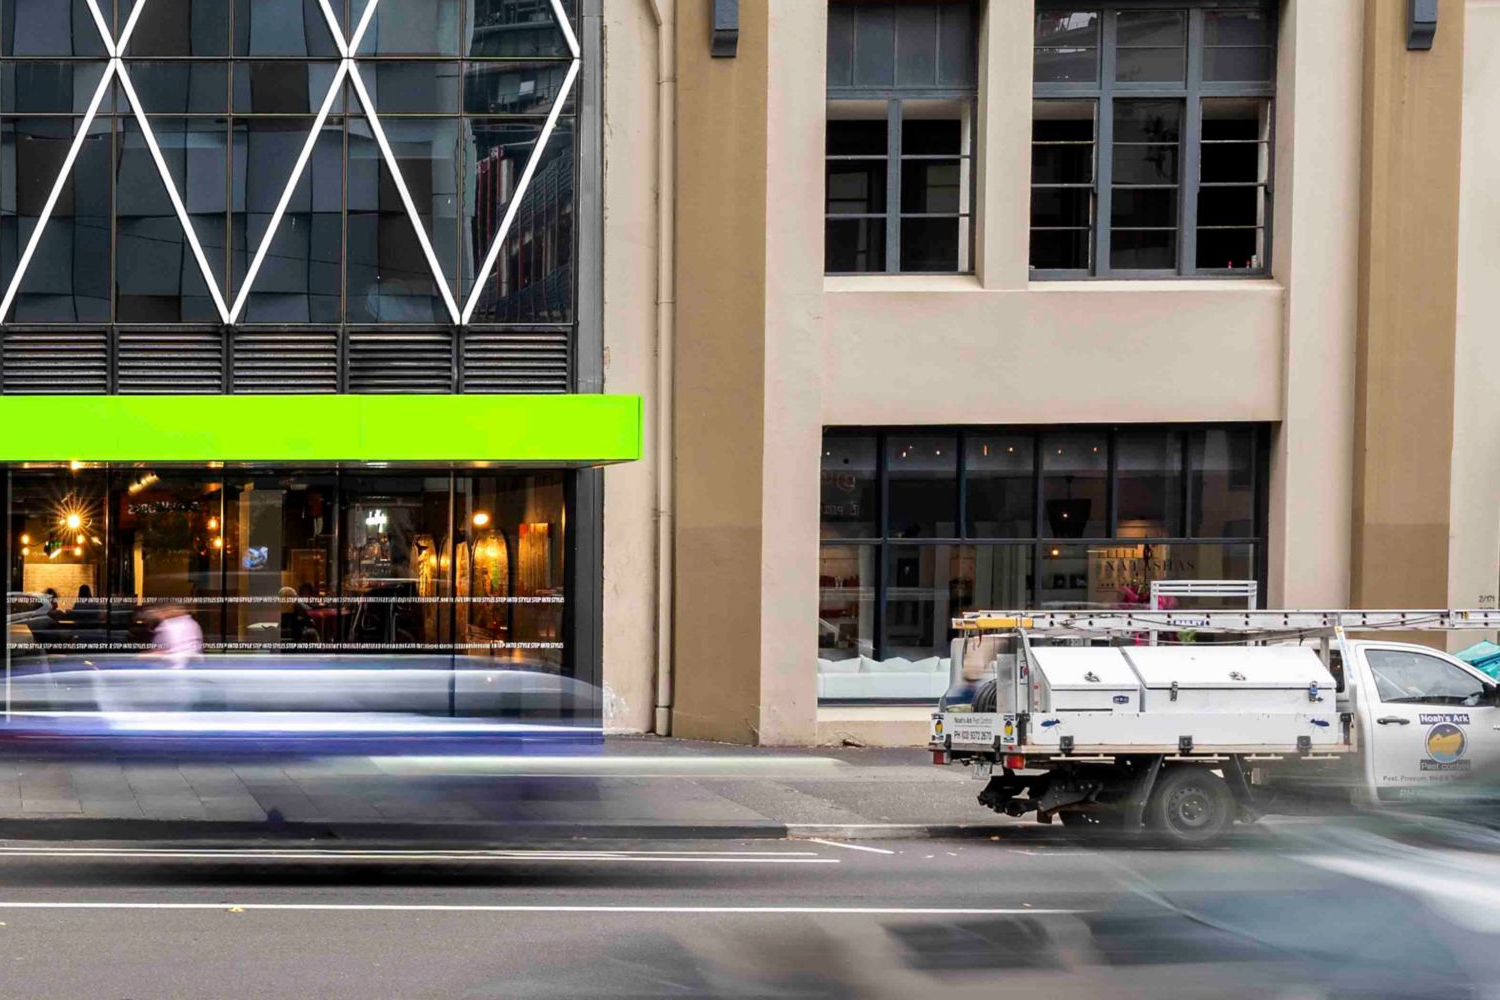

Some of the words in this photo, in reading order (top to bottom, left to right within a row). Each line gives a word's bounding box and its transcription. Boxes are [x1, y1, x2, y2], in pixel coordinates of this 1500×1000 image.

[1106, 560, 1195, 572] NATASHAS
[1421, 713, 1451, 722] Noah's
[1452, 713, 1469, 722] Ark
[1421, 762, 1440, 770] Pest
